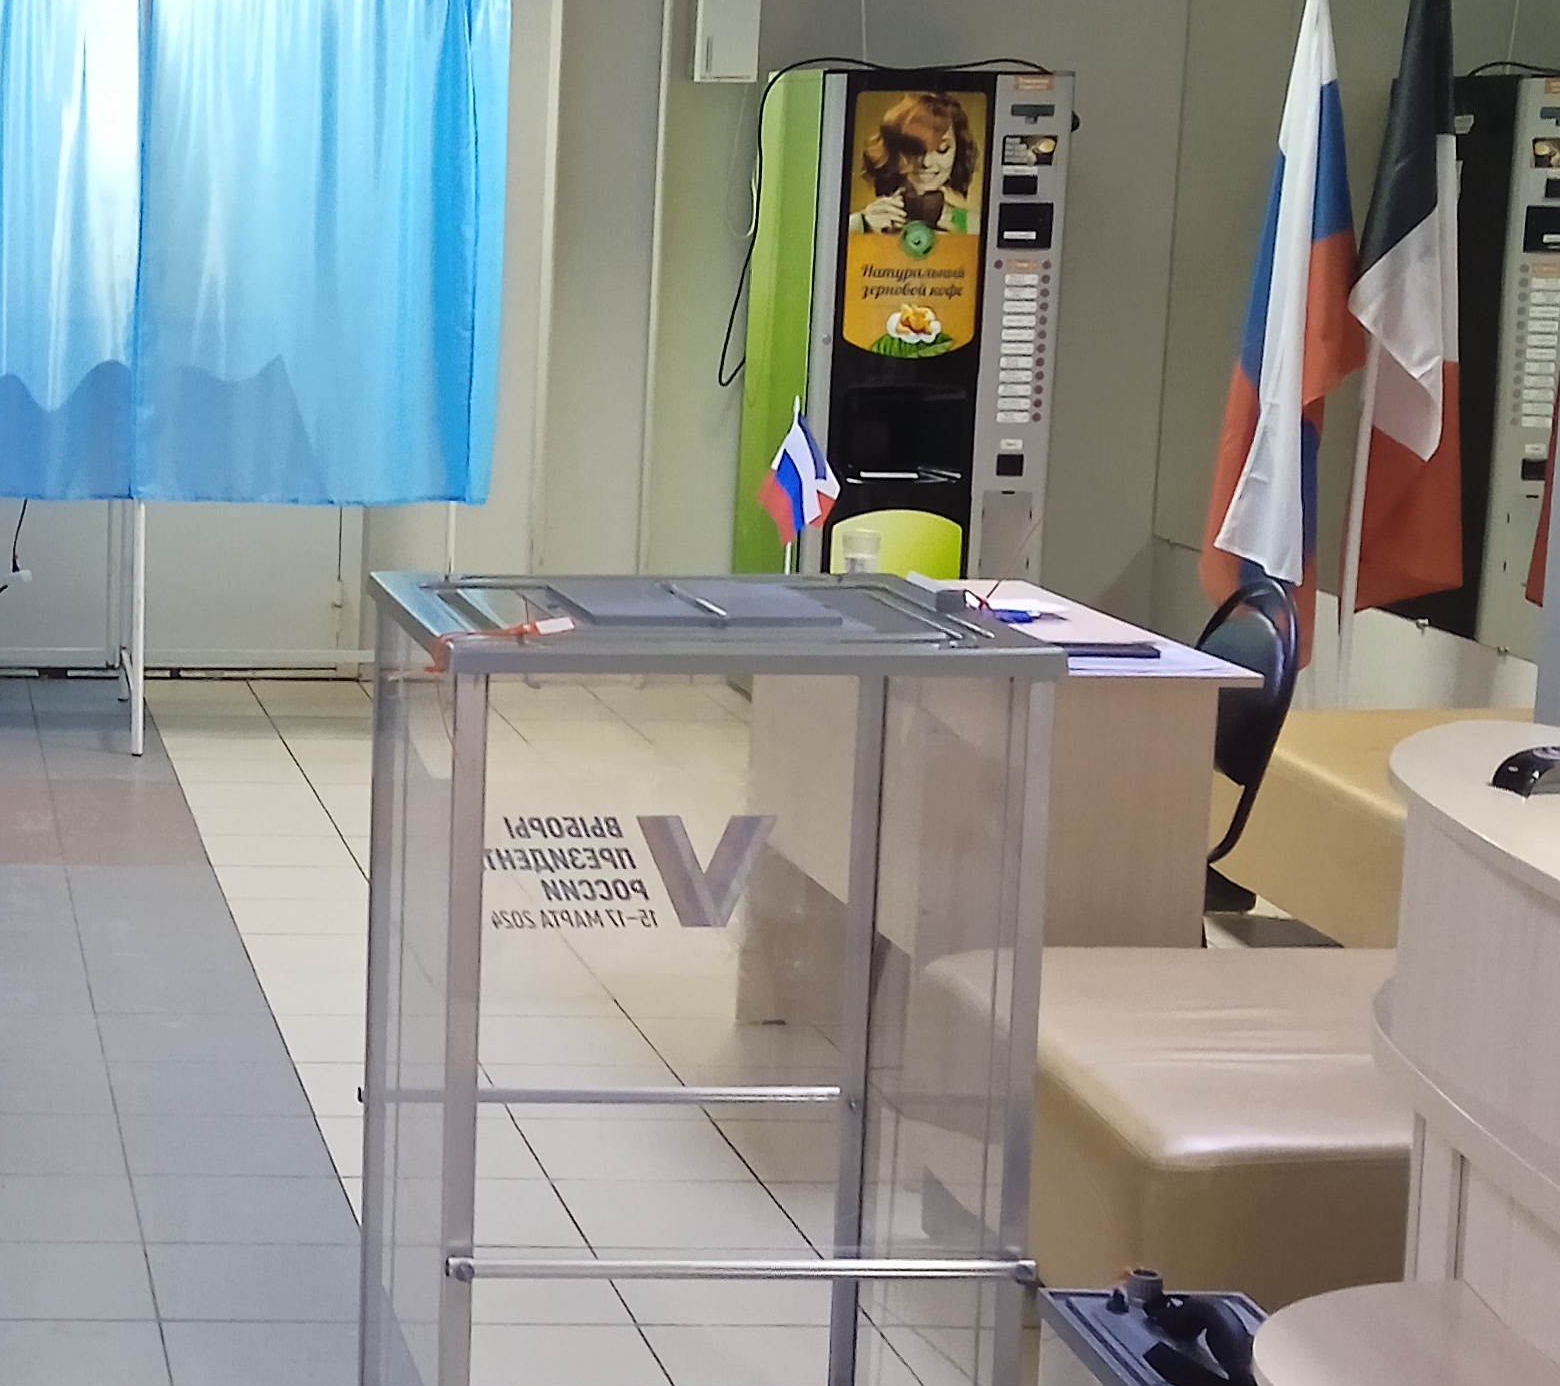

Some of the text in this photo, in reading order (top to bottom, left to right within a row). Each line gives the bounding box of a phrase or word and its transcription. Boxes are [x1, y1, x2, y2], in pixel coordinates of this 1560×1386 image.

[860, 263, 966, 282] Натуральный
[861, 283, 963, 300] зерновой кофе
